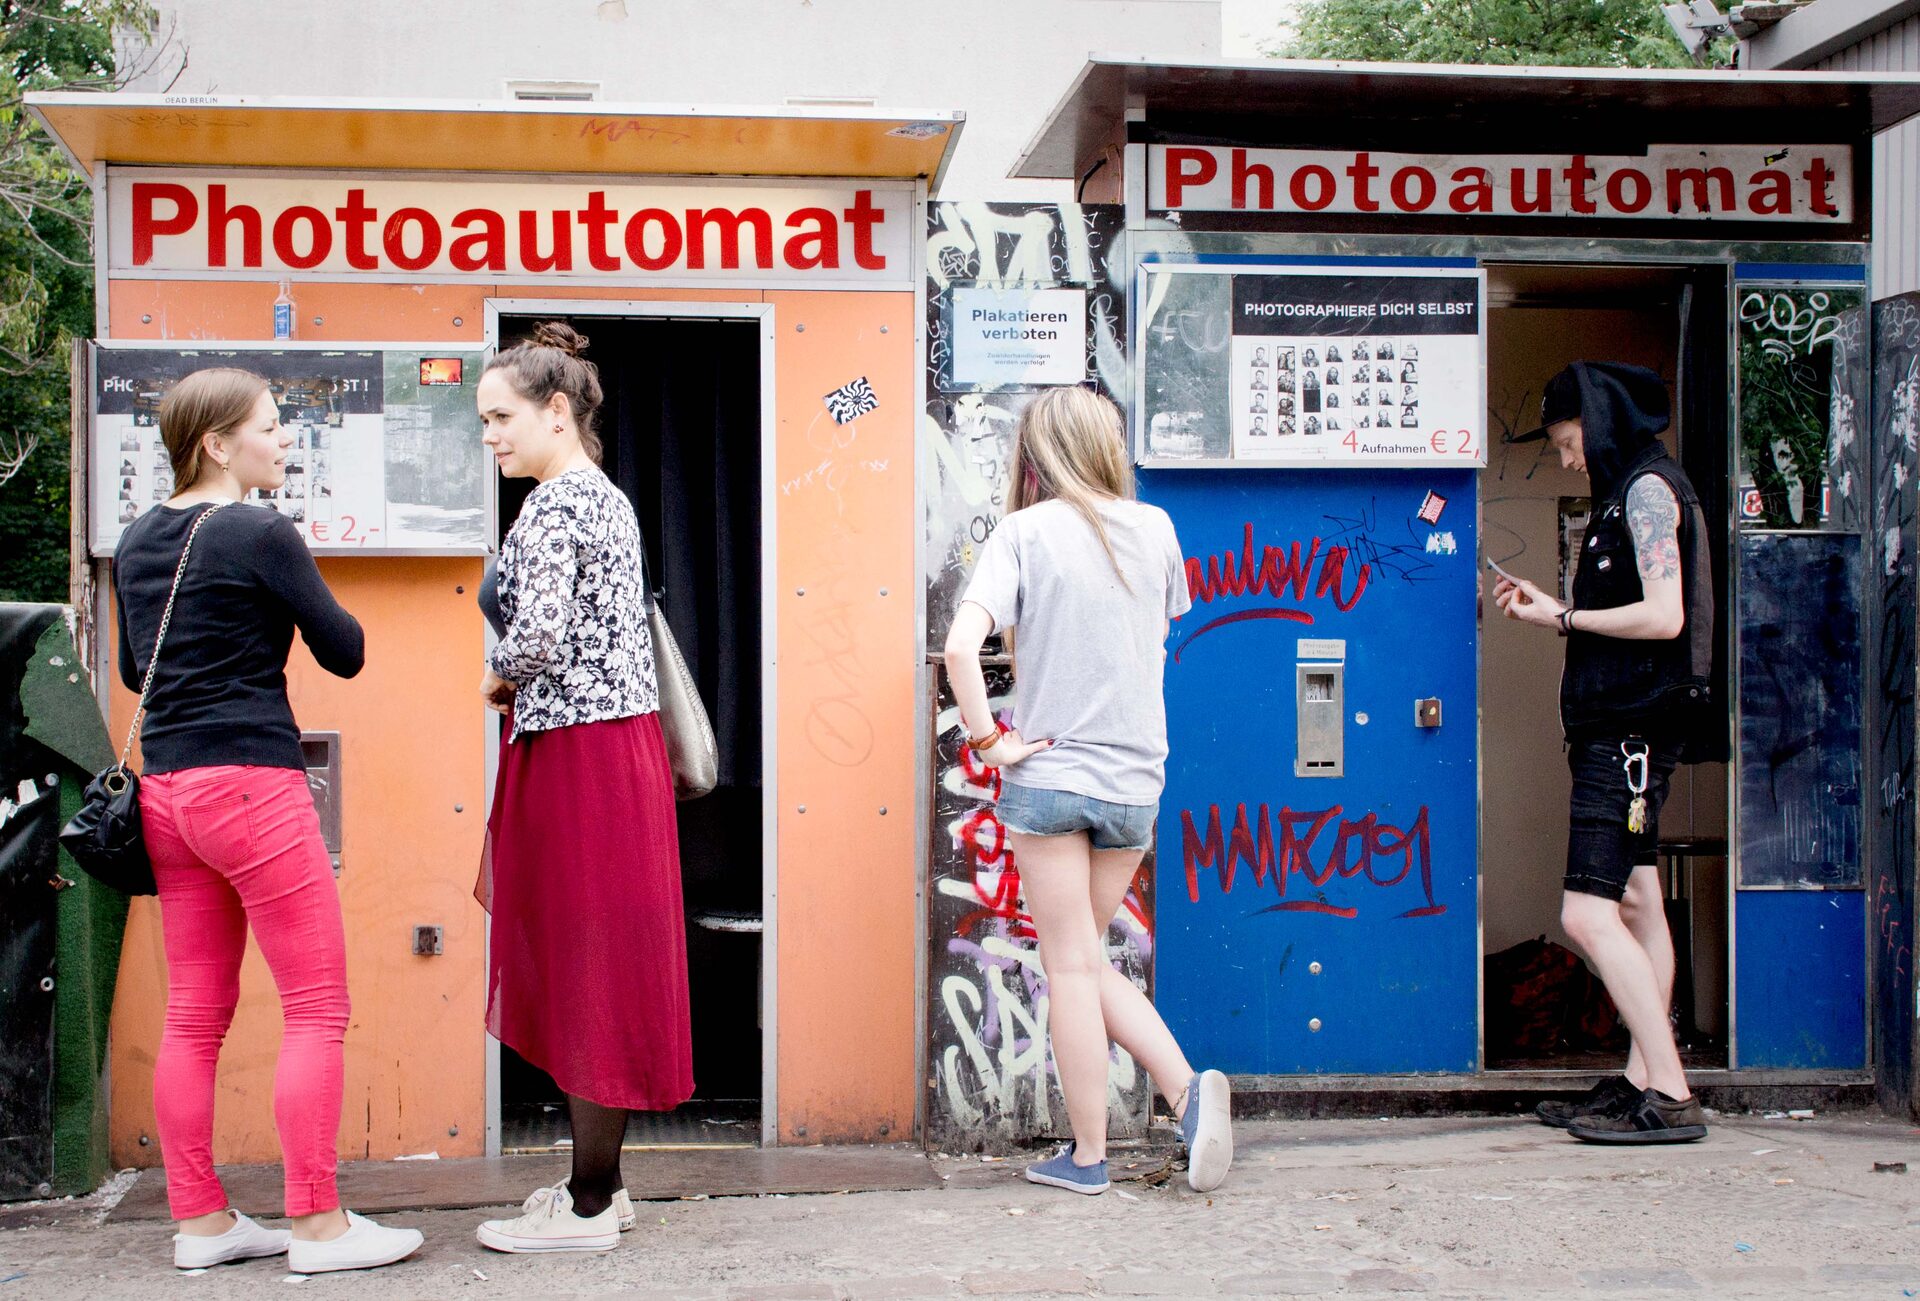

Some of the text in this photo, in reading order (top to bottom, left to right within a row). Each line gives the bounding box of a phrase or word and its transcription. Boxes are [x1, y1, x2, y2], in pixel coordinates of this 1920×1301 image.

[1165, 147, 1839, 215] Photoautomat
[132, 182, 886, 271] Photoautomat
[972, 308, 1068, 323] Plakatieren
[1244, 302, 1474, 317] PHOTOGRAPHIERE DICH SELBST
[982, 327, 1058, 340] verboten
[1342, 430, 1359, 454] 4
[1360, 443, 1427, 454] Aufnahmen
[1430, 429, 1448, 454] €
[310, 520, 330, 542] €
